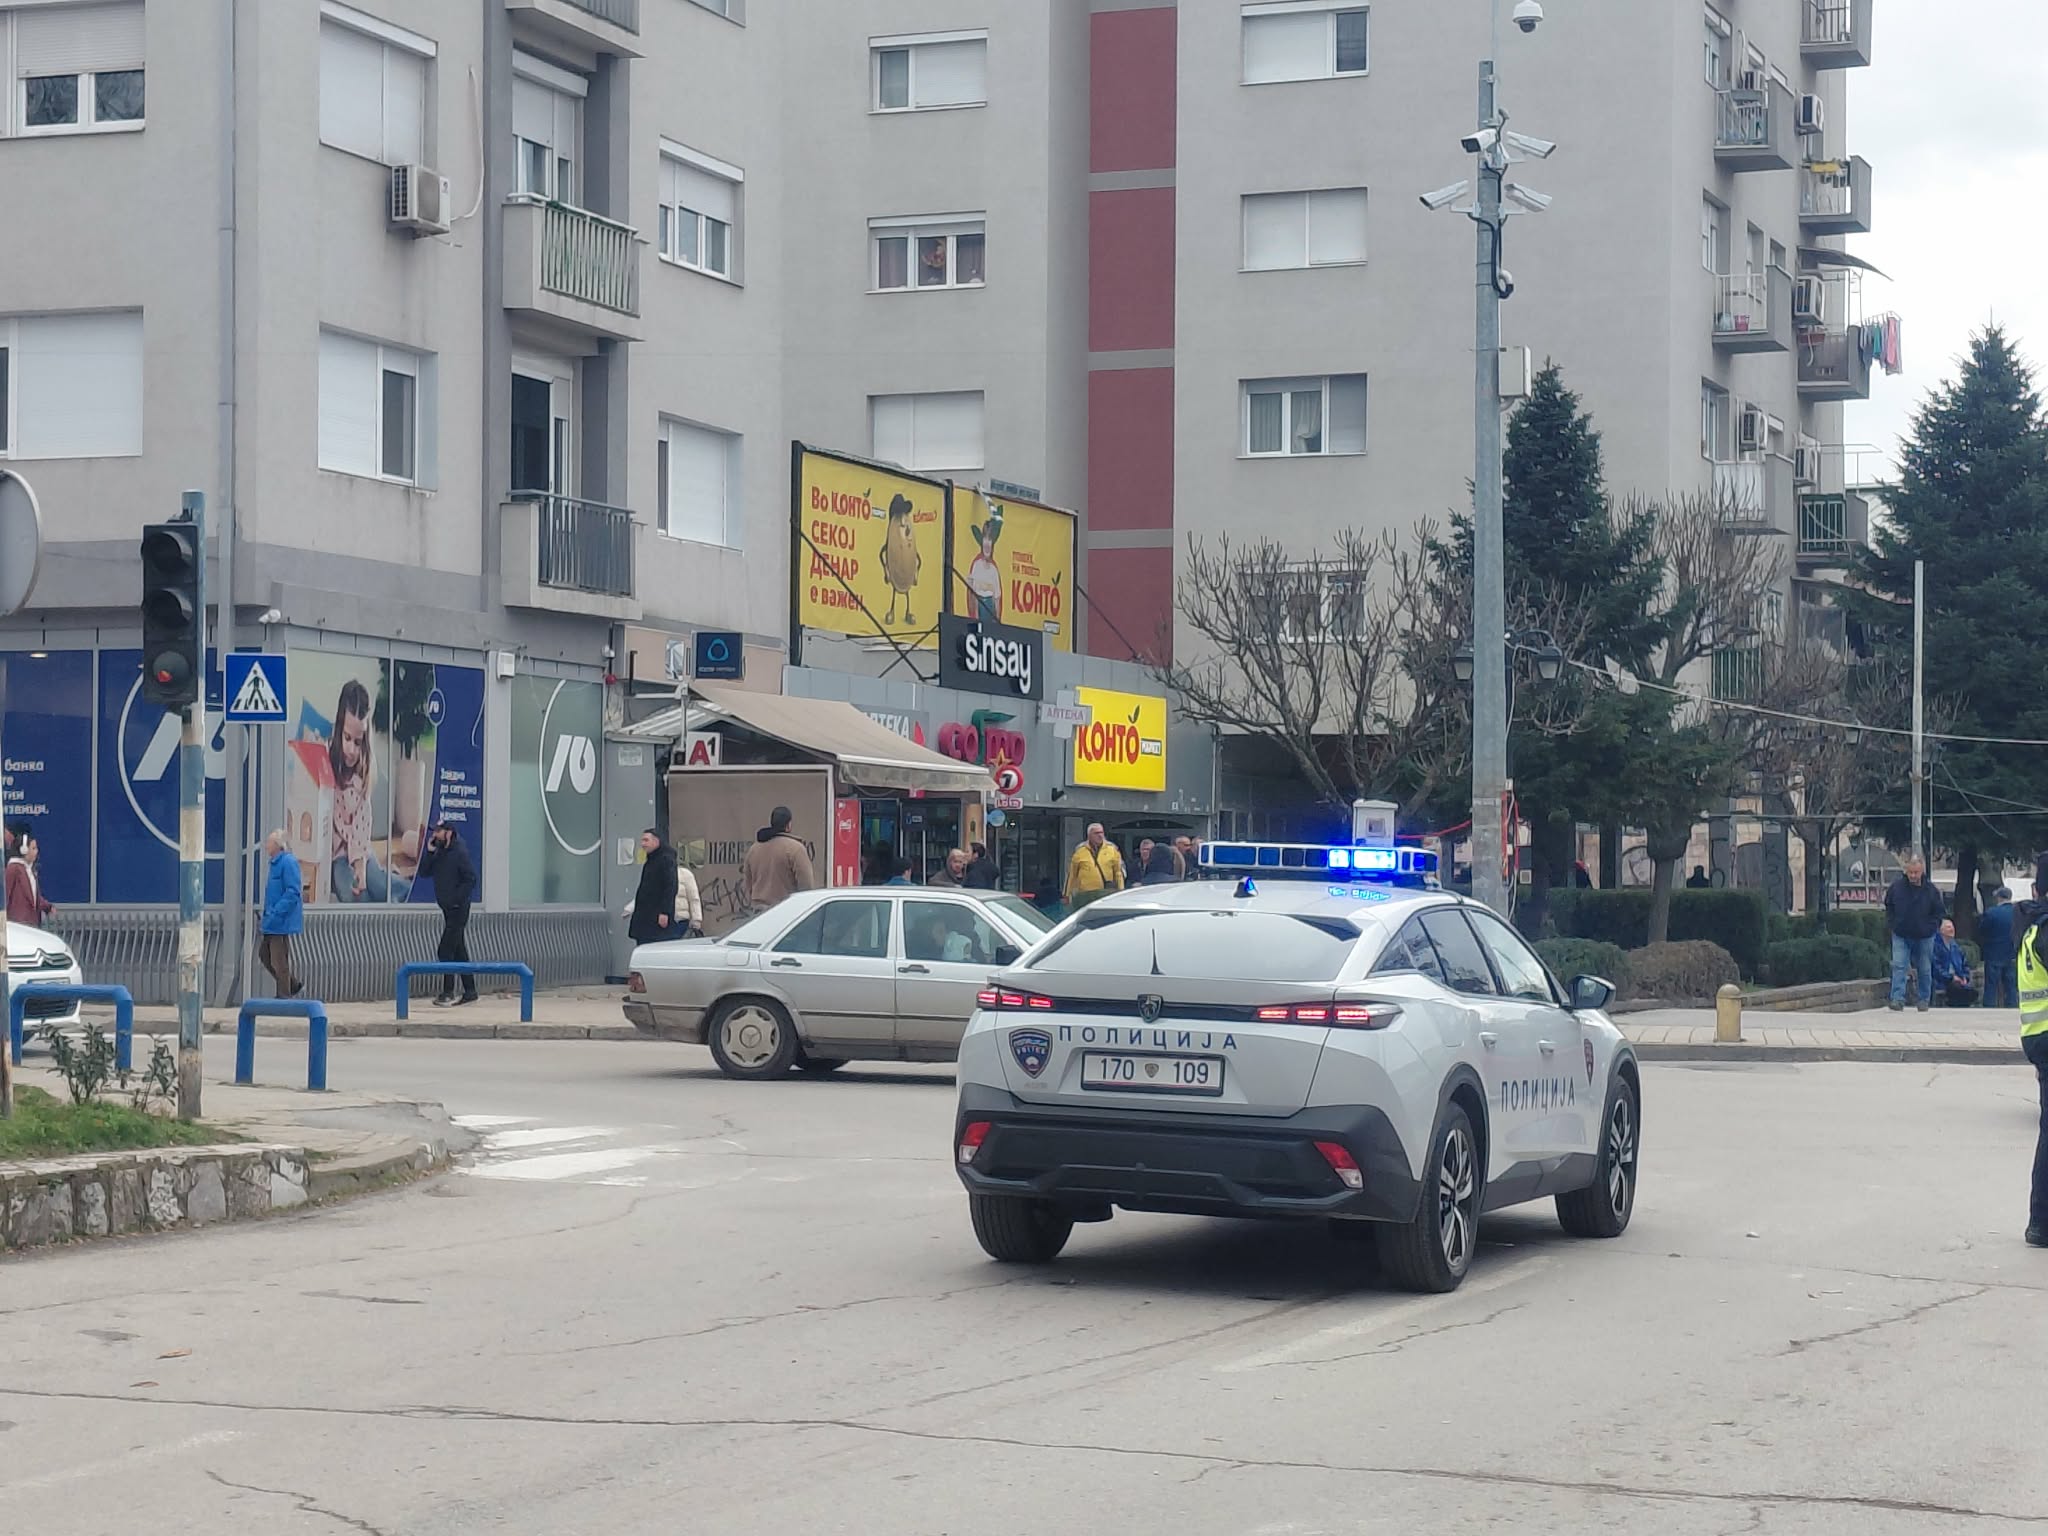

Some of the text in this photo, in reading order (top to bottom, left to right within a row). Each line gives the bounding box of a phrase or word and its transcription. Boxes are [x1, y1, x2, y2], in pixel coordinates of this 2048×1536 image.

[811, 486, 828, 512] Во
[831, 490, 872, 521] КОНТО
[811, 519, 855, 551] СЕКОЈ
[810, 550, 859, 581] ДЕНАР
[1011, 579, 1061, 617] КОНТО
[1077, 720, 1141, 765] КОНТО
[1058, 1025, 1238, 1050] ПОЛИЦИЈА
[1100, 1057, 1209, 1084] 170 109
[1501, 1077, 1575, 1114] ПОЛИЦИЈА
